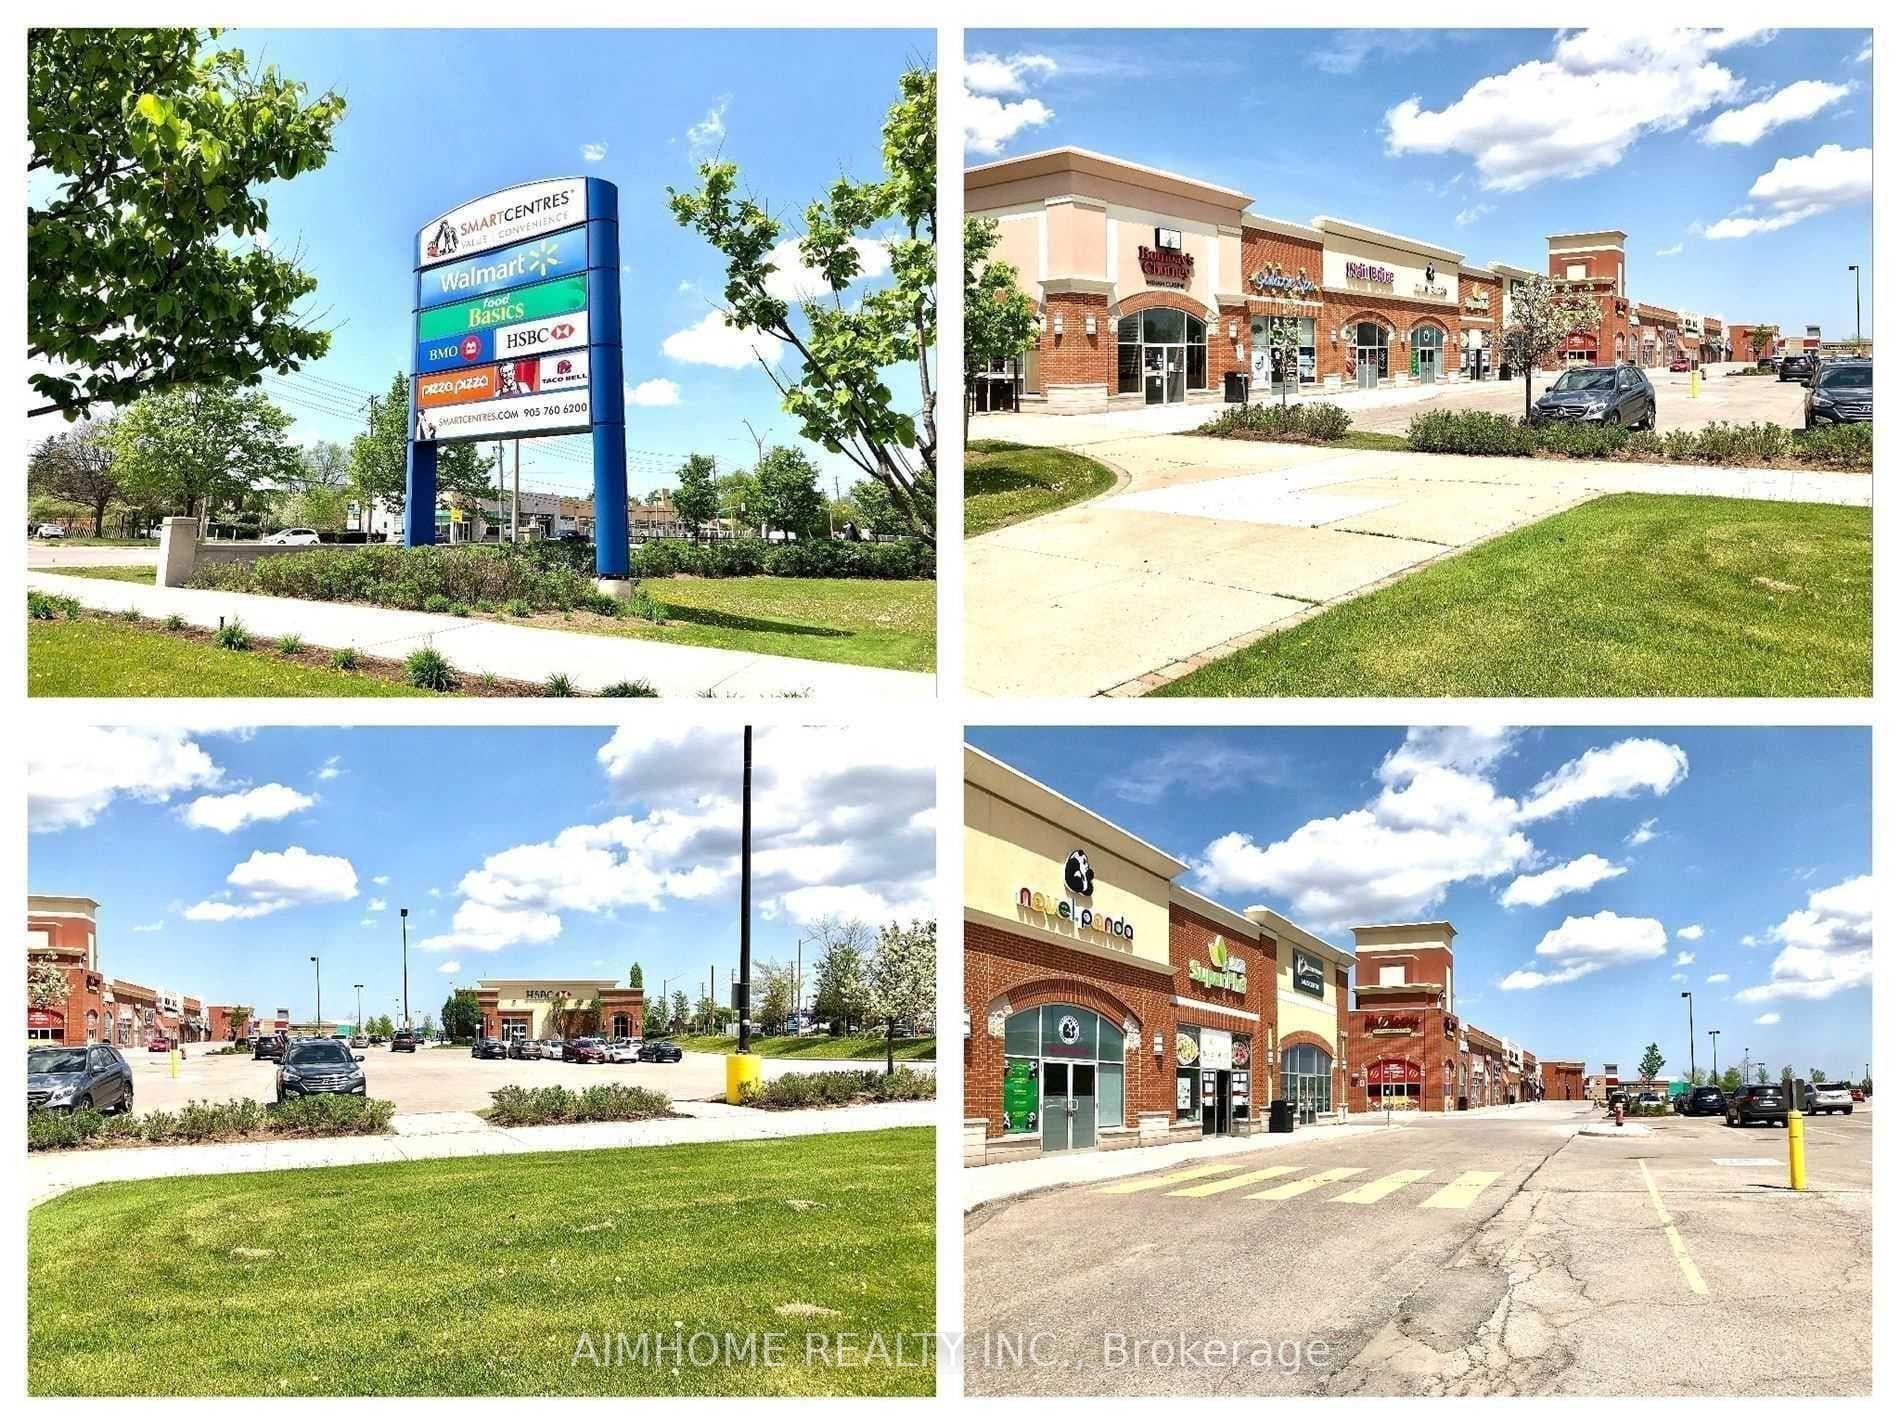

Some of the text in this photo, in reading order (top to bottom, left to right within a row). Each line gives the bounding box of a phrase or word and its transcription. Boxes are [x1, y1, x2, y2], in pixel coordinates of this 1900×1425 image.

[460, 190, 570, 237] SMARTCENTRES
[498, 211, 570, 239] CONVENIENCE
[440, 254, 525, 293] Walmart
[507, 328, 550, 349] HSBC
[429, 346, 458, 361] BMO
[542, 373, 588, 384] TACO BELL
[439, 402, 588, 427] SMARTCENTRES.COM 905 760 6200
[1080, 909, 1134, 941] panda
